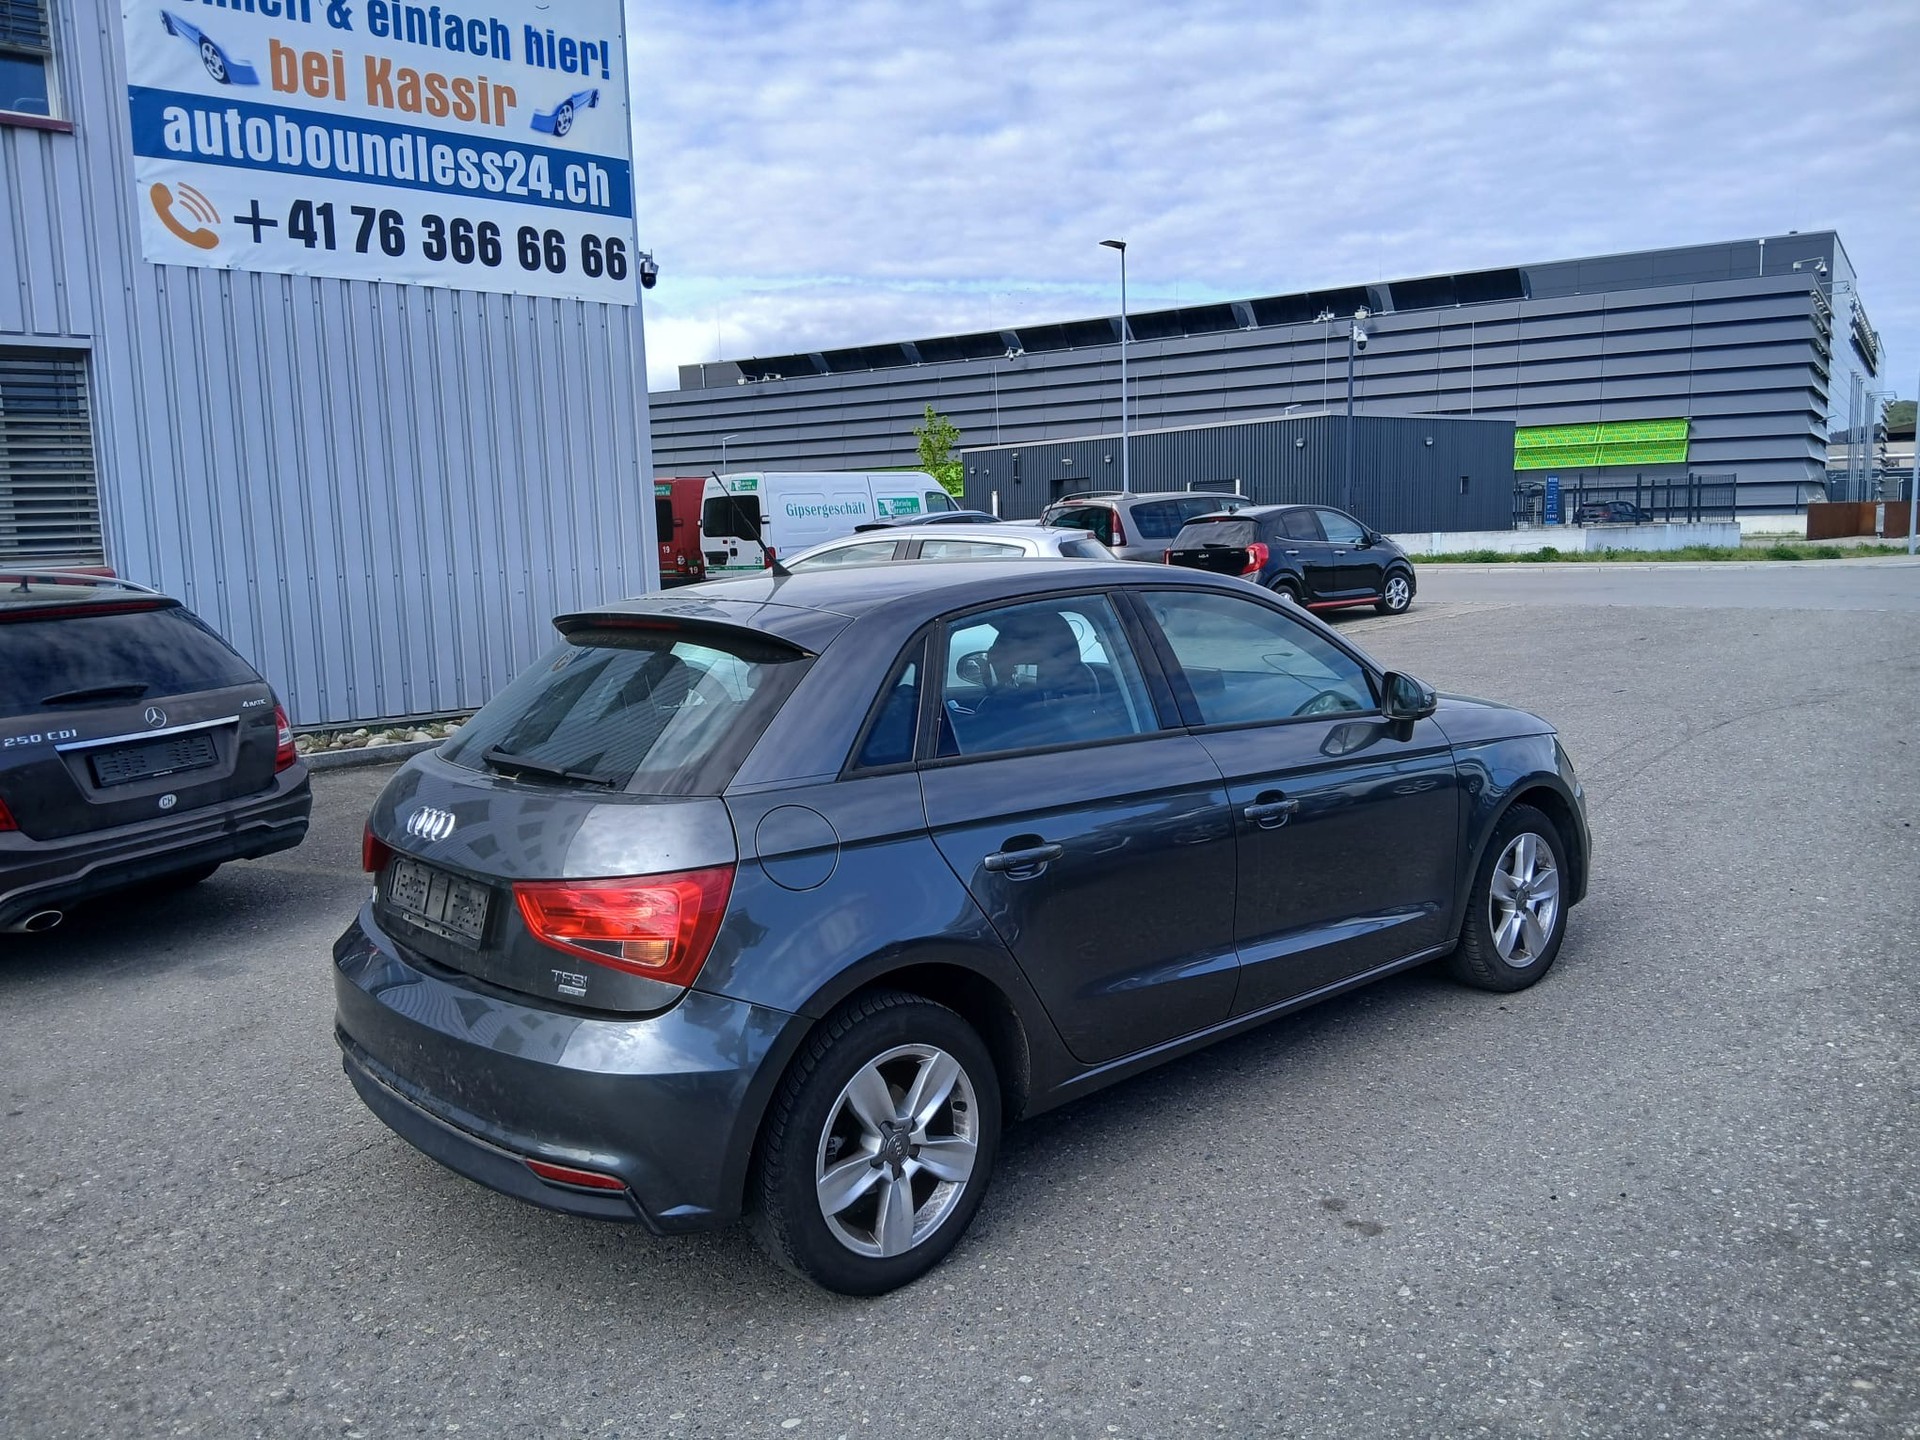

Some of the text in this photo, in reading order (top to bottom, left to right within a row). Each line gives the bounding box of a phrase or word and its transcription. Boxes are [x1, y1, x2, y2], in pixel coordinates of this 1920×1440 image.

[326, 0, 353, 31] &
[367, 0, 511, 61] einfach
[523, 24, 610, 80] hier!
[268, 38, 518, 127] bei Kassir
[162, 106, 611, 207] autoboundless24.ch
[350, 205, 405, 257] 76
[421, 214, 503, 267] 366
[517, 225, 567, 274] 66
[581, 233, 628, 281] 66
[785, 501, 868, 519] Gipsergeschäft
[662, 545, 670, 553] 19
[754, 556, 763, 564] 29
[689, 566, 698, 574] 19
[4, 728, 77, 747] 250 CDI
[162, 795, 174, 807] CH
[551, 969, 588, 988] TFSI
